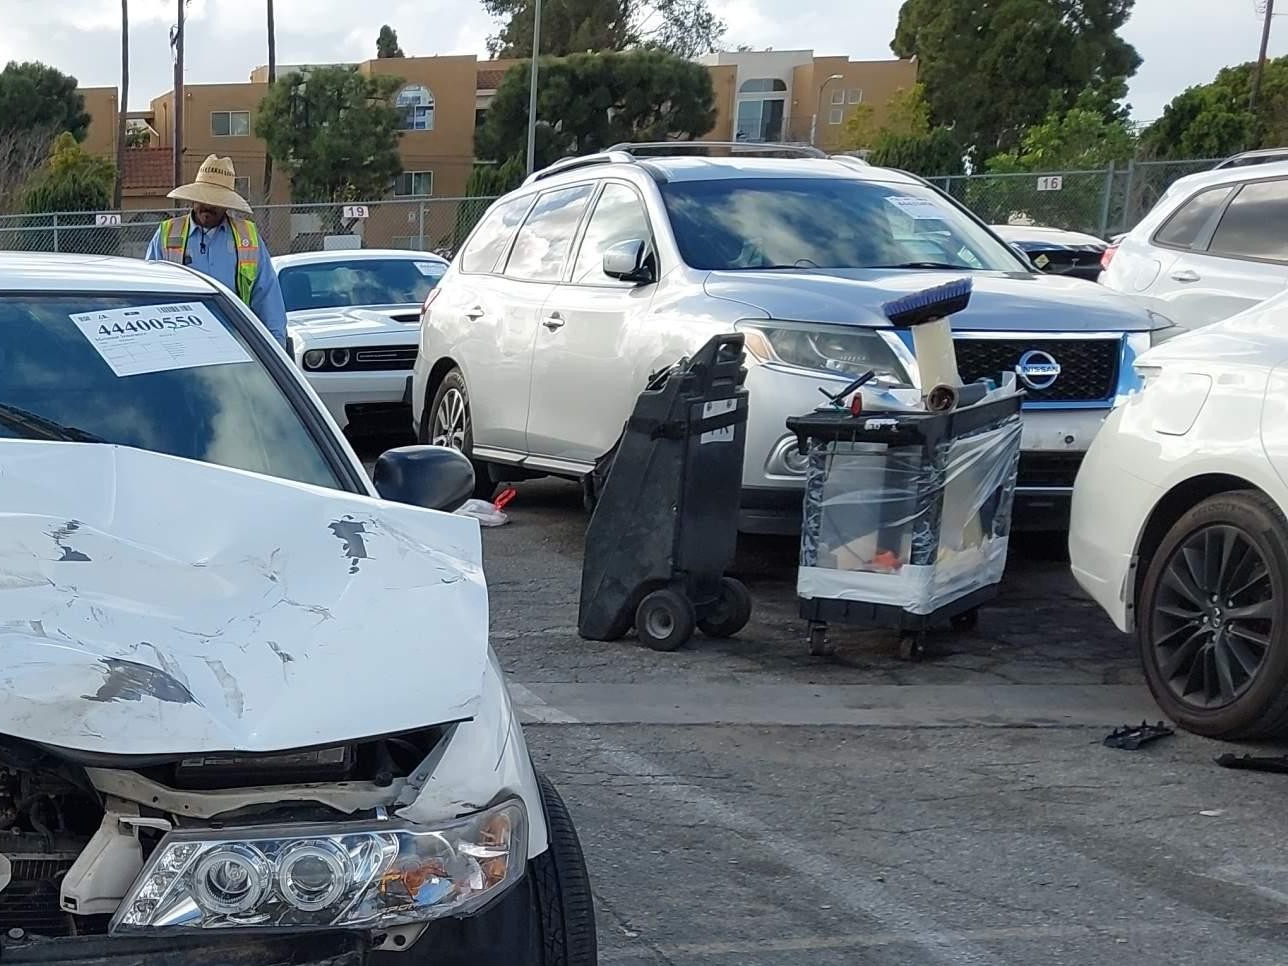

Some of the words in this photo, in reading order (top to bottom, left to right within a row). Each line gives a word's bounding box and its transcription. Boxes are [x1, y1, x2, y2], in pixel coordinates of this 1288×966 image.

[1043, 178, 1059, 190] 16
[348, 207, 365, 217] 19
[100, 215, 118, 225] 20
[98, 314, 204, 337] 44400550
[1021, 365, 1058, 373] NISSAN
